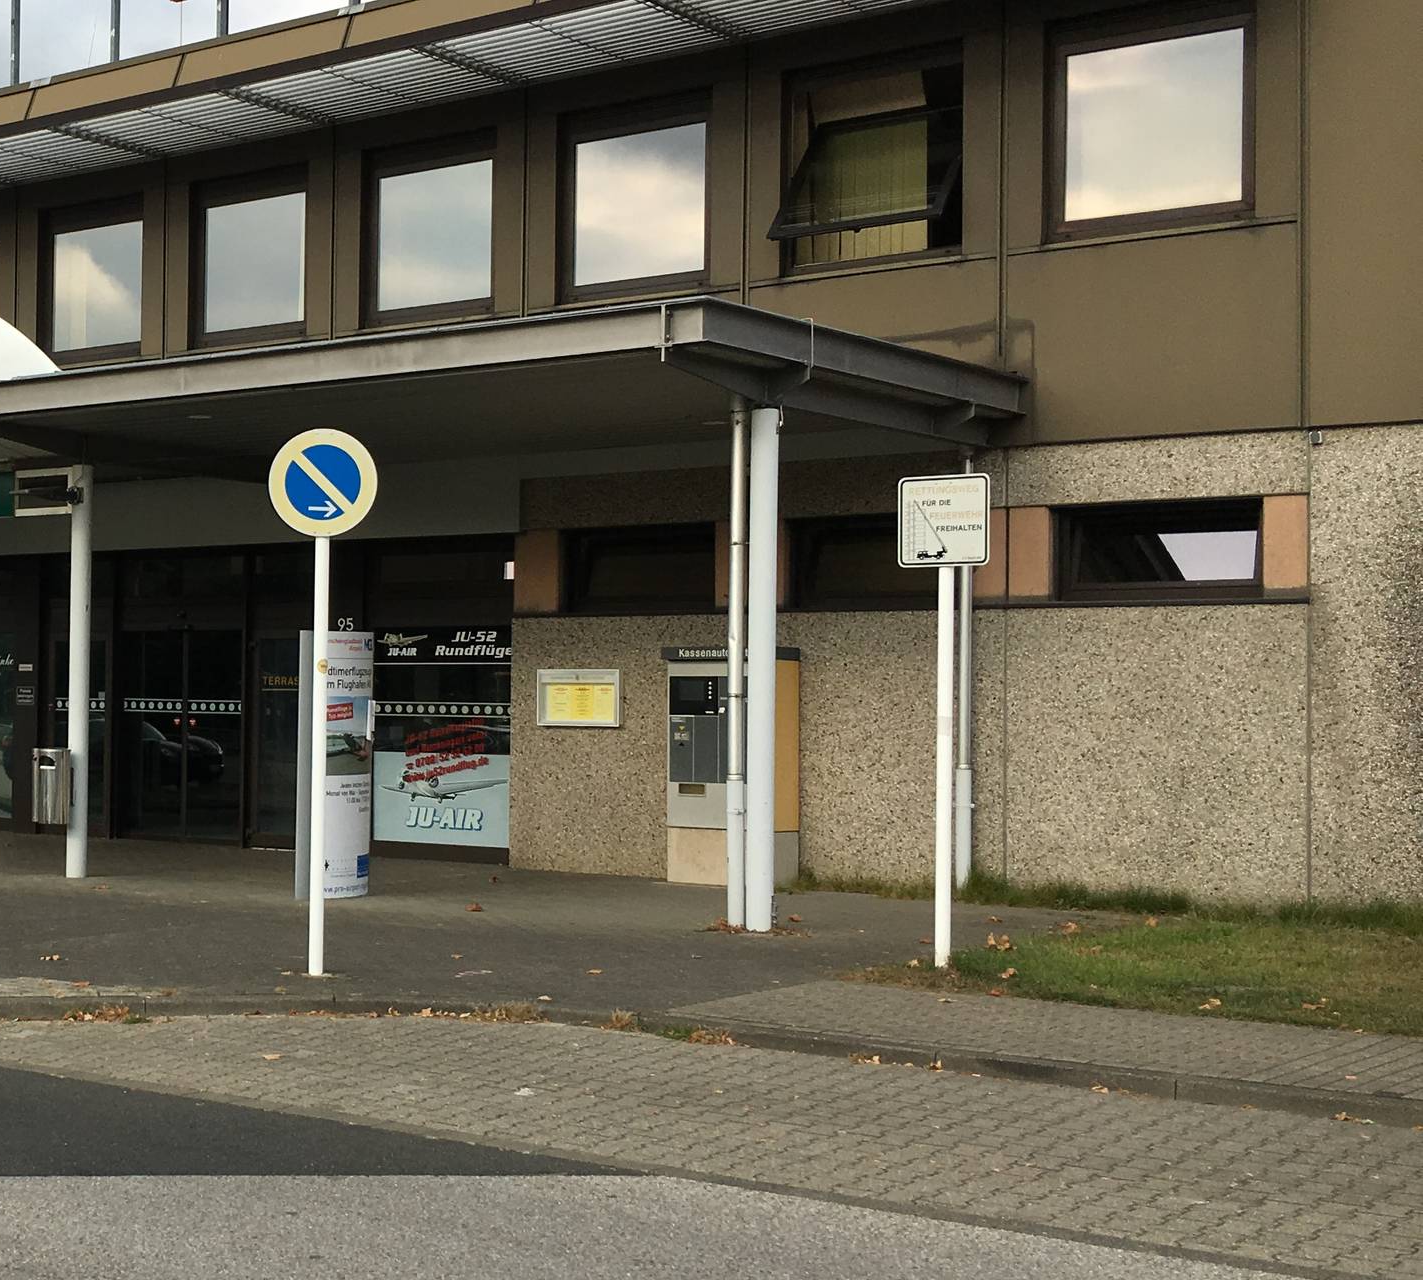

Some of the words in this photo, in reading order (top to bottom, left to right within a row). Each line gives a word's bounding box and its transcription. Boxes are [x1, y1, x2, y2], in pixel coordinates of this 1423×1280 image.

[922, 499, 937, 507] FÜR
[936, 524, 983, 532] FREIHALTEN
[337, 618, 354, 632] 95
[451, 631, 497, 643] JU-52
[387, 647, 417, 656] JU-AIR
[435, 644, 513, 659] Rundflüge
[678, 648, 748, 657] Kassenautot
[405, 806, 483, 830] JU-AIR
